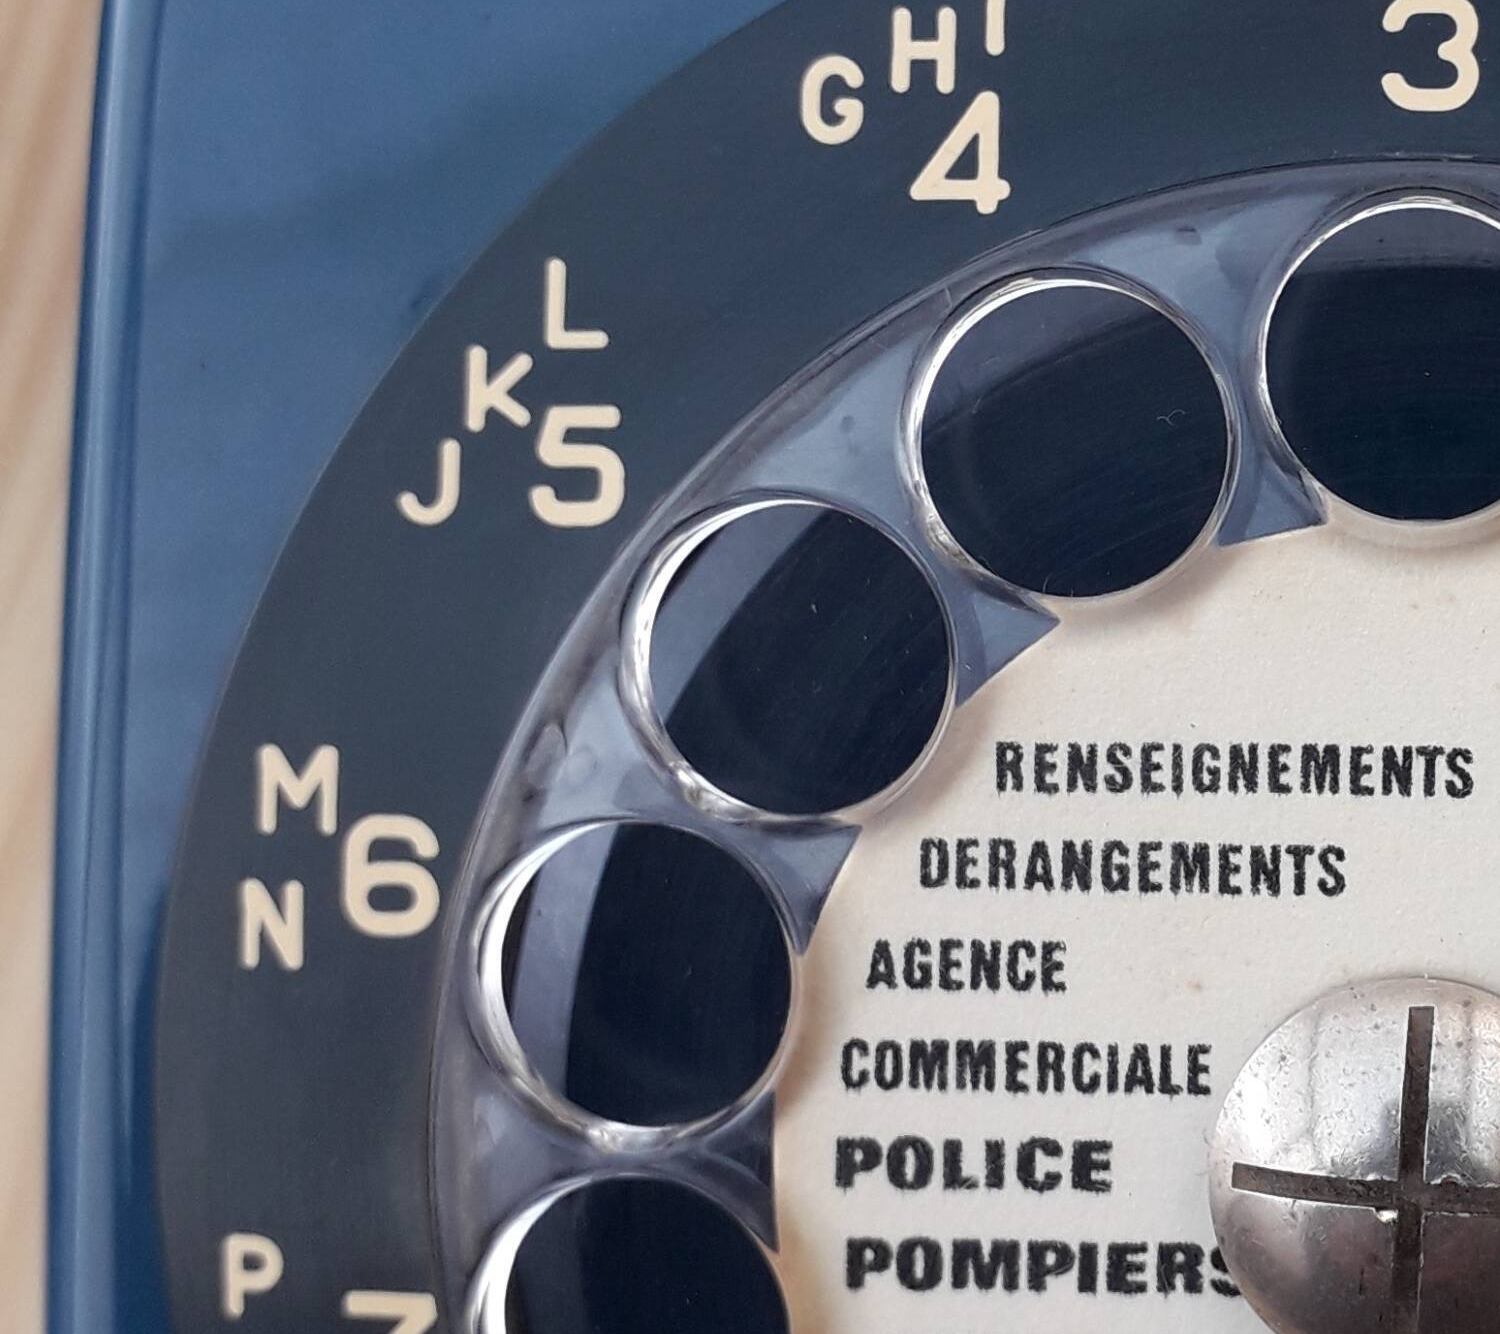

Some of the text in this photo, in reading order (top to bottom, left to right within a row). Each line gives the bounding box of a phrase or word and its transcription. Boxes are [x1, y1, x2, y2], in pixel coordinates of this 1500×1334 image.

[908, 89, 1012, 216] 4
[527, 403, 627, 529] 5
[994, 739, 1476, 800] RENSEIGNEMENTS
[340, 812, 441, 939] 6
[918, 836, 1348, 898] DERANGEMENTS
[864, 937, 1069, 995] AGENCE
[839, 1037, 1213, 1098] COMMERCIALE
[834, 1134, 1115, 1195] POLICE
